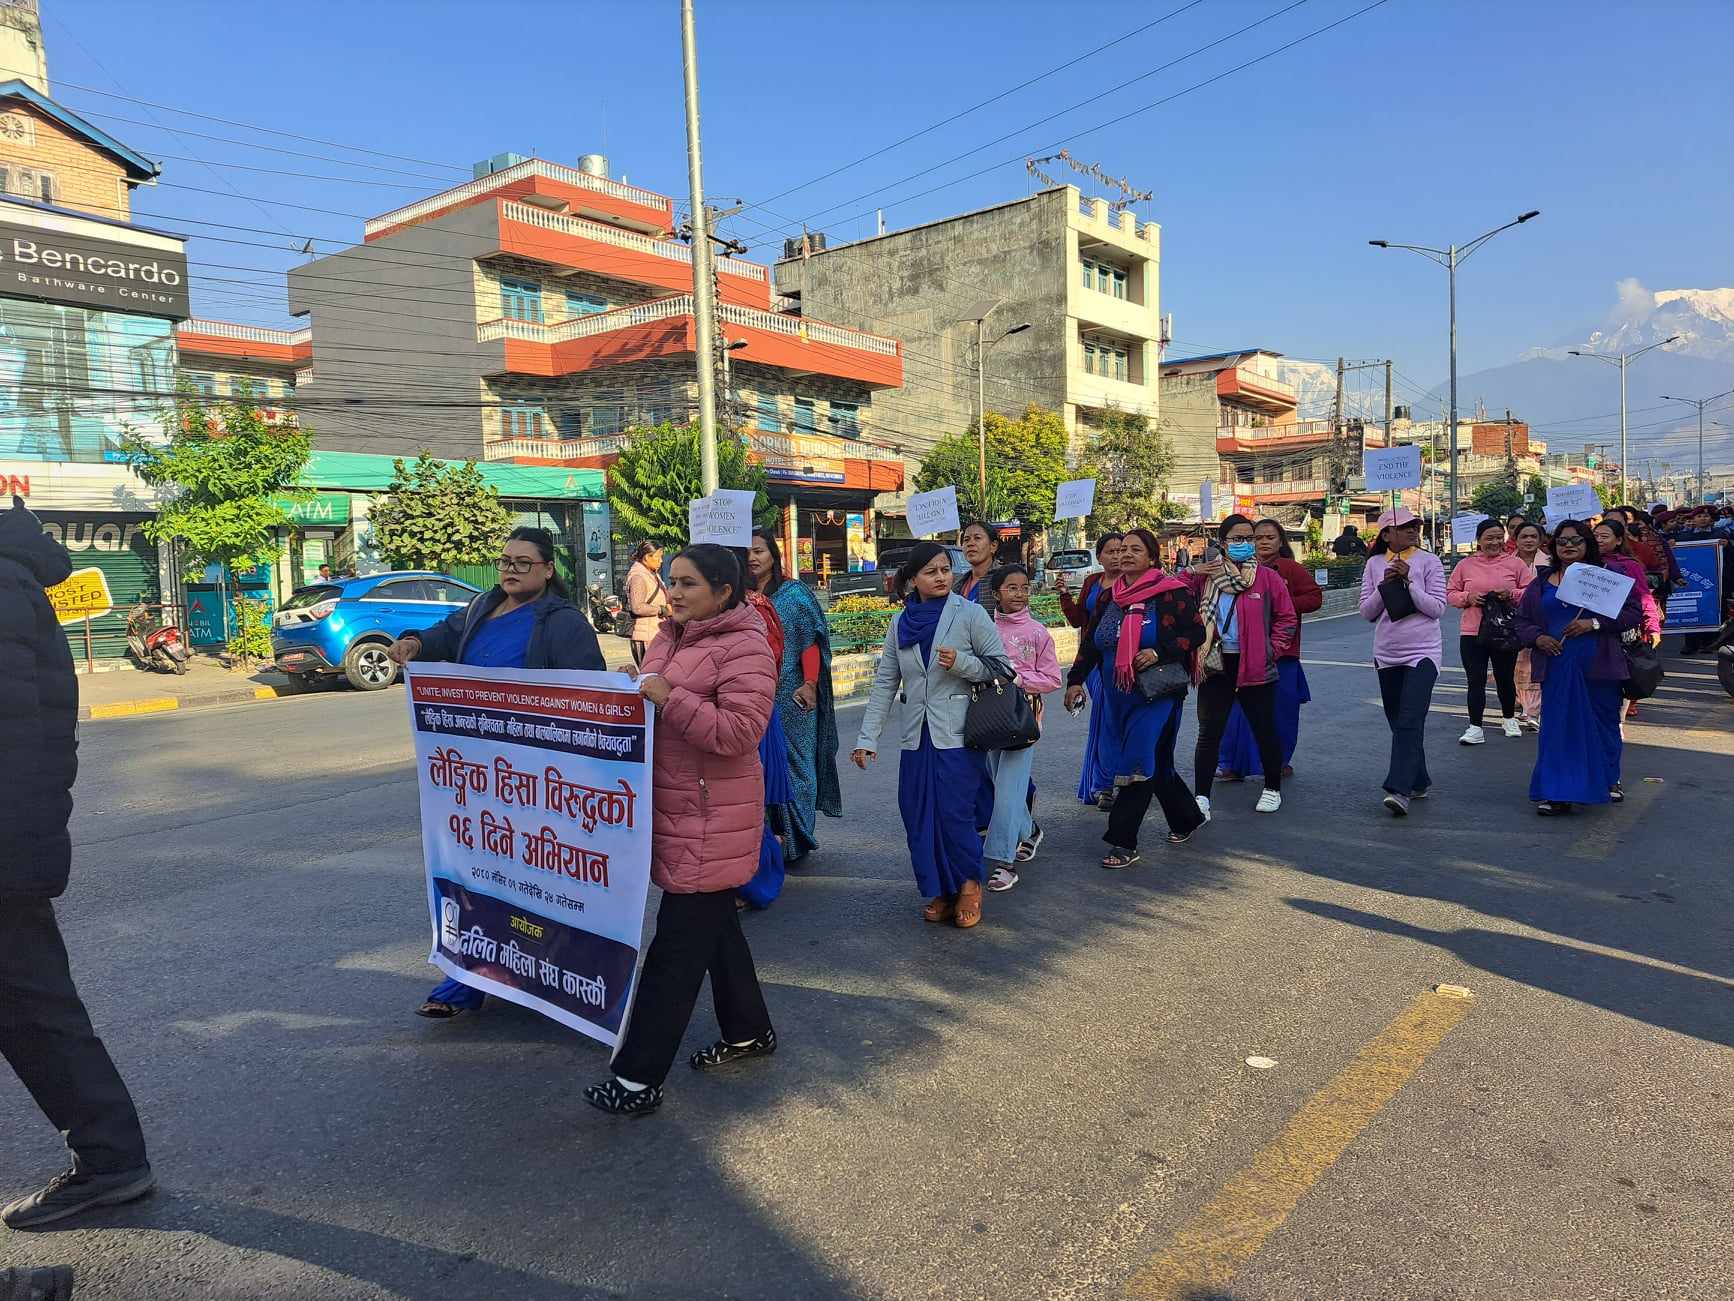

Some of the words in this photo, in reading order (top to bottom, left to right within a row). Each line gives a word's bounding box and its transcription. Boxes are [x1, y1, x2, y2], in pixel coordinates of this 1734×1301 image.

[13, 238, 180, 285] Bencardo
[17, 272, 105, 293] Bathware
[119, 288, 175, 304] Center
[287, 500, 333, 520] ATM
[704, 511, 736, 521] WOMEN
[441, 688, 464, 699] INVEST
[465, 690, 475, 700] TO
[475, 690, 506, 702] PREVENT
[506, 693, 540, 706] VIOLENCE
[541, 697, 569, 710] AGAINST
[570, 700, 598, 714] WOMEN
[599, 704, 604, 714] &
[494, 756, 539, 807] हिंसा
[449, 813, 474, 850] १६
[480, 809, 515, 859] दिने
[521, 825, 609, 887] अभियान
[510, 915, 544, 938] आयोजक
[460, 925, 498, 962] दलित
[500, 939, 536, 979] महिला
[538, 957, 560, 989] संघ
[562, 970, 607, 1010] कास्की
